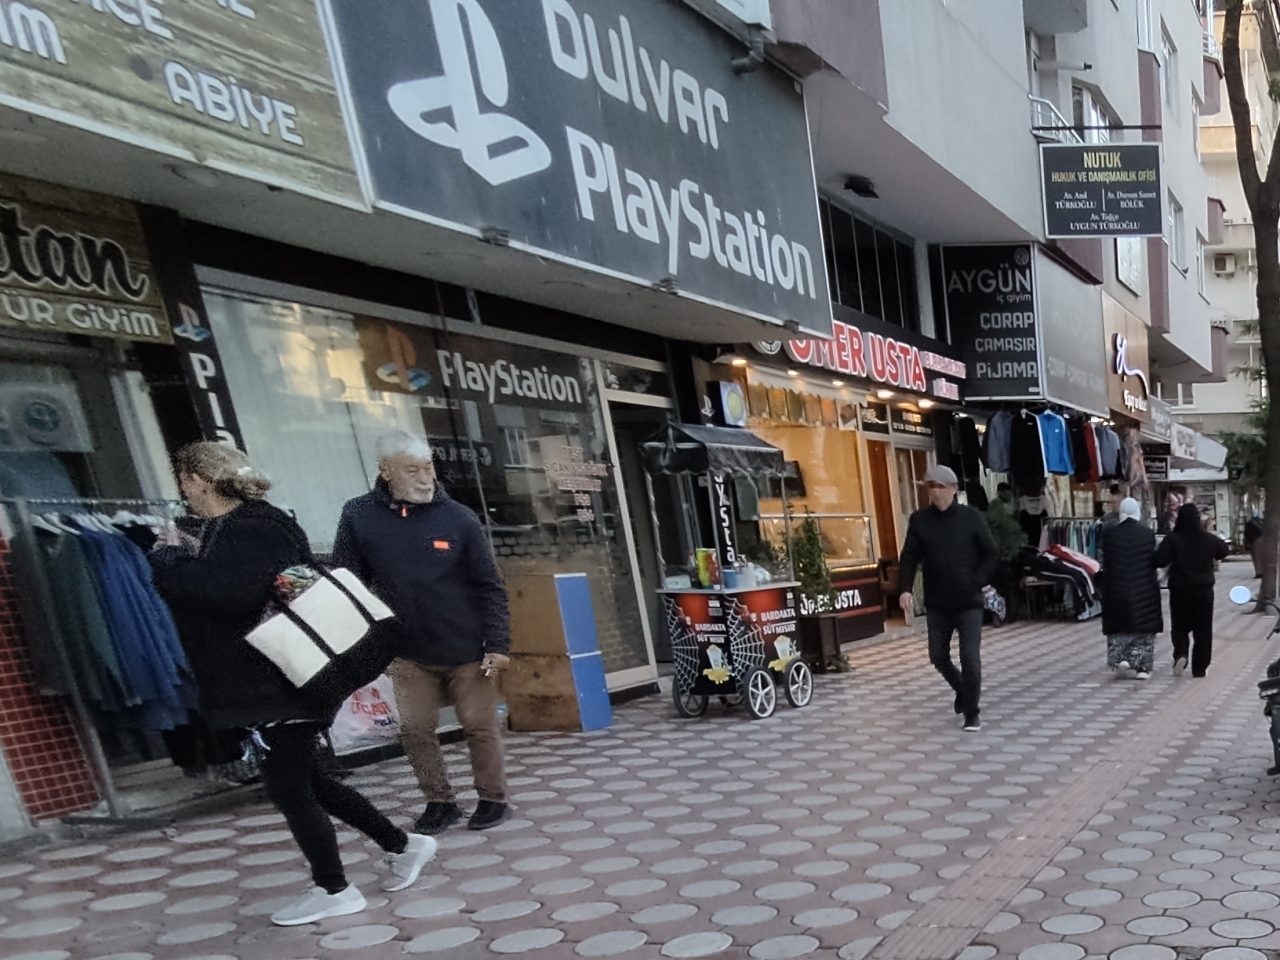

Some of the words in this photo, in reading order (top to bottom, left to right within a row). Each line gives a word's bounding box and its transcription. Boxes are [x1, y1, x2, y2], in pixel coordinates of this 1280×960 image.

[1083, 151, 1122, 169] NUTUK
[1051, 171, 1077, 183] HUKUK
[1078, 171, 1087, 183] VE
[565, 125, 817, 300] PlayStation
[947, 262, 1032, 293] AYGÜN
[980, 312, 1034, 331] ÇORAP
[975, 337, 1036, 353] ÇAMAŞIR
[867, 331, 927, 393] USTA
[436, 349, 582, 404] PlayStation
